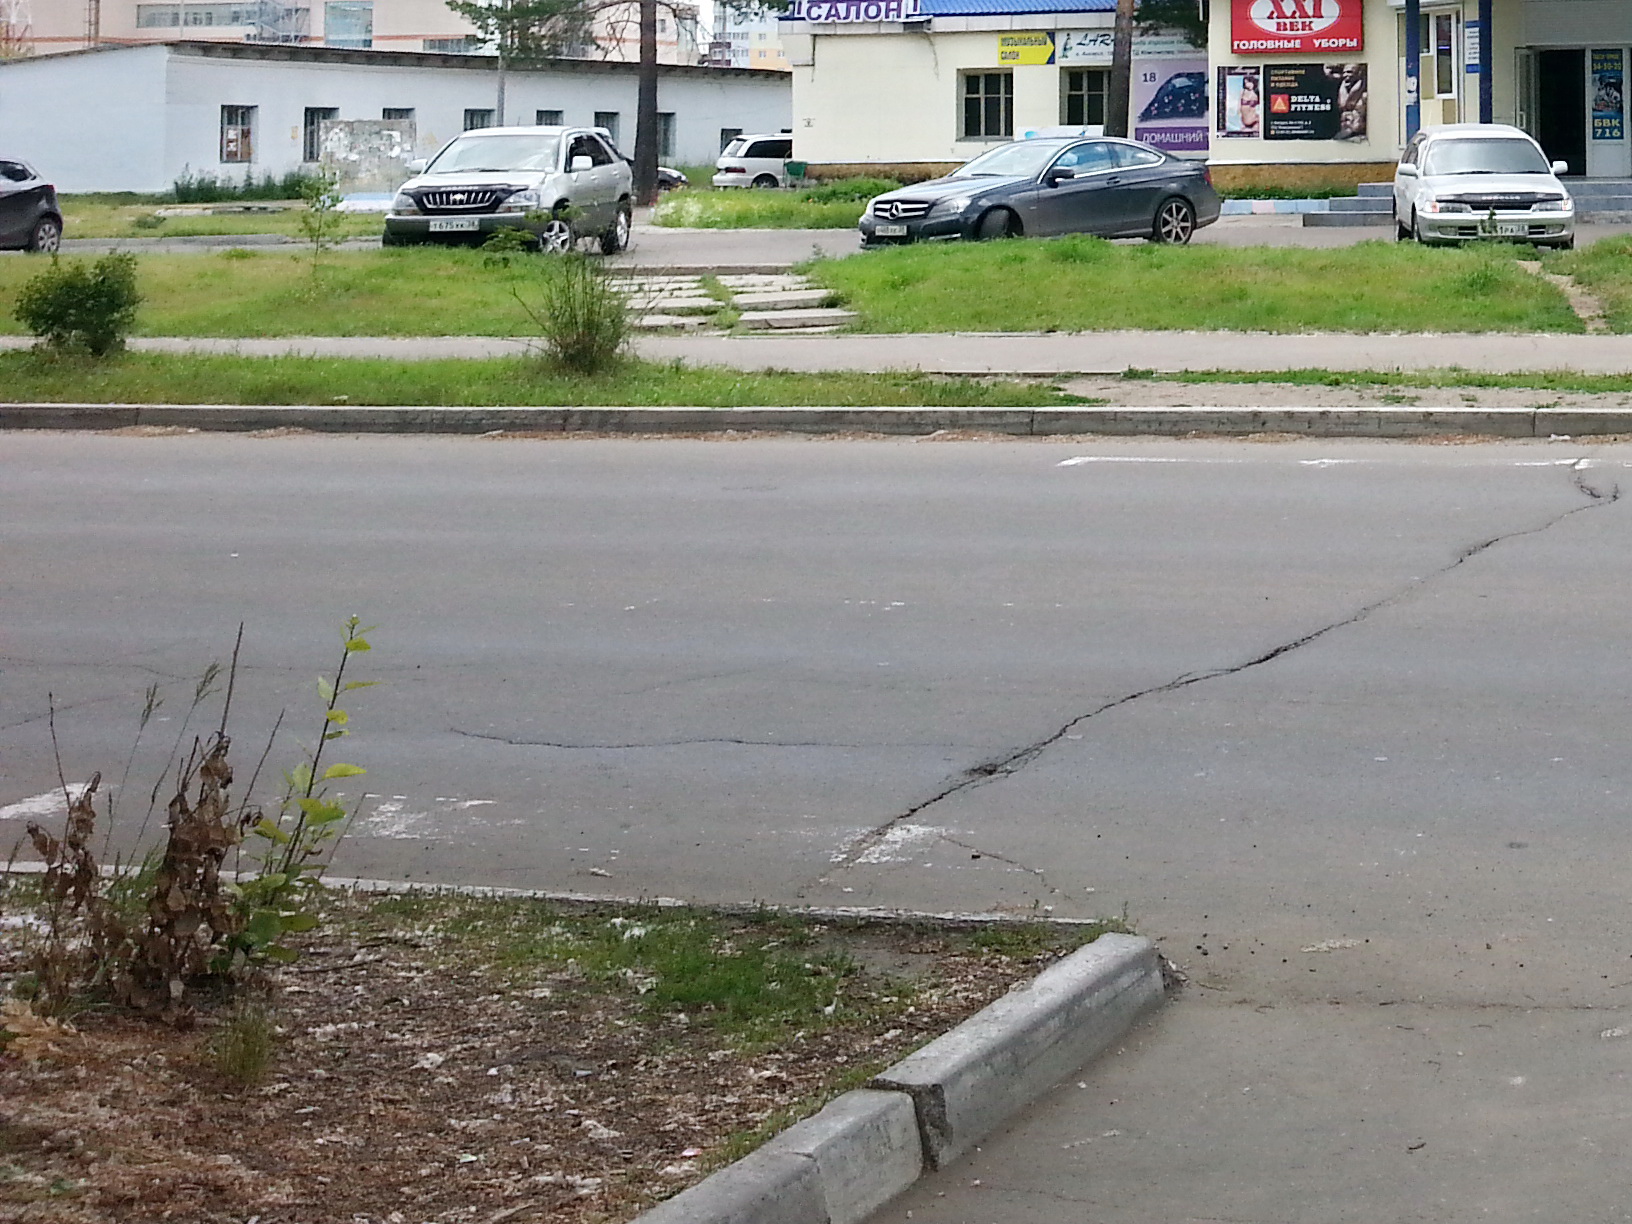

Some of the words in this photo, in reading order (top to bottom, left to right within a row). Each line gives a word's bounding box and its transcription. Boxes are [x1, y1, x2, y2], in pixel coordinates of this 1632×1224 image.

[806, 0, 903, 21] САЛОН
[1276, 21, 1315, 32] ВЕК
[1233, 39, 1302, 50] ГОЛОВНЫЕ
[1313, 38, 1358, 48] УБОРЫ
[1142, 73, 1156, 82] 18
[1291, 95, 1321, 103] DELTA
[1291, 104, 1331, 112] FITNESS
[1142, 130, 1203, 144] ДОМАШНИЙ
[1594, 129, 1621, 137] 716
